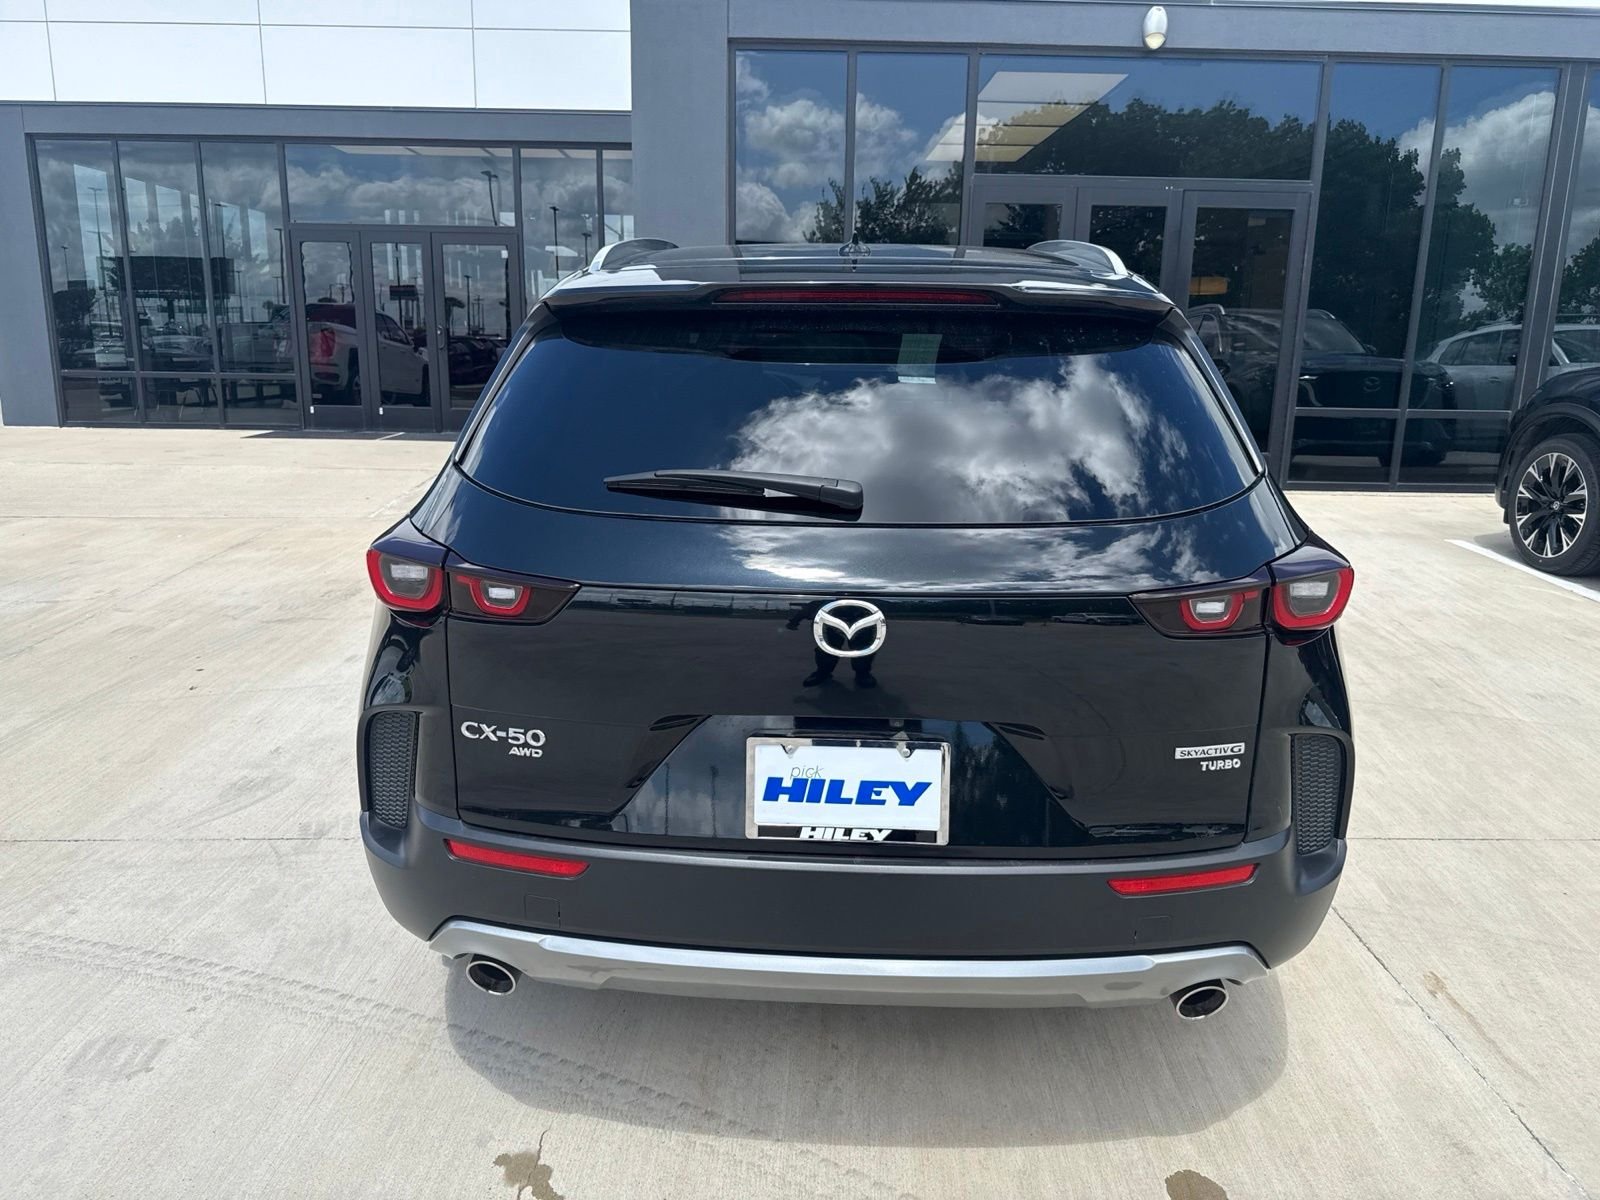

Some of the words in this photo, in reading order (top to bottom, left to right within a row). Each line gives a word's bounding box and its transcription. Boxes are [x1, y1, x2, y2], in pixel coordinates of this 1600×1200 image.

[461, 721, 546, 747] CX-50
[508, 746, 543, 758] AWD
[790, 764, 824, 779] pick
[1200, 758, 1241, 771] TURBO
[762, 776, 933, 806] HILEY
[799, 826, 893, 841] HILEY
